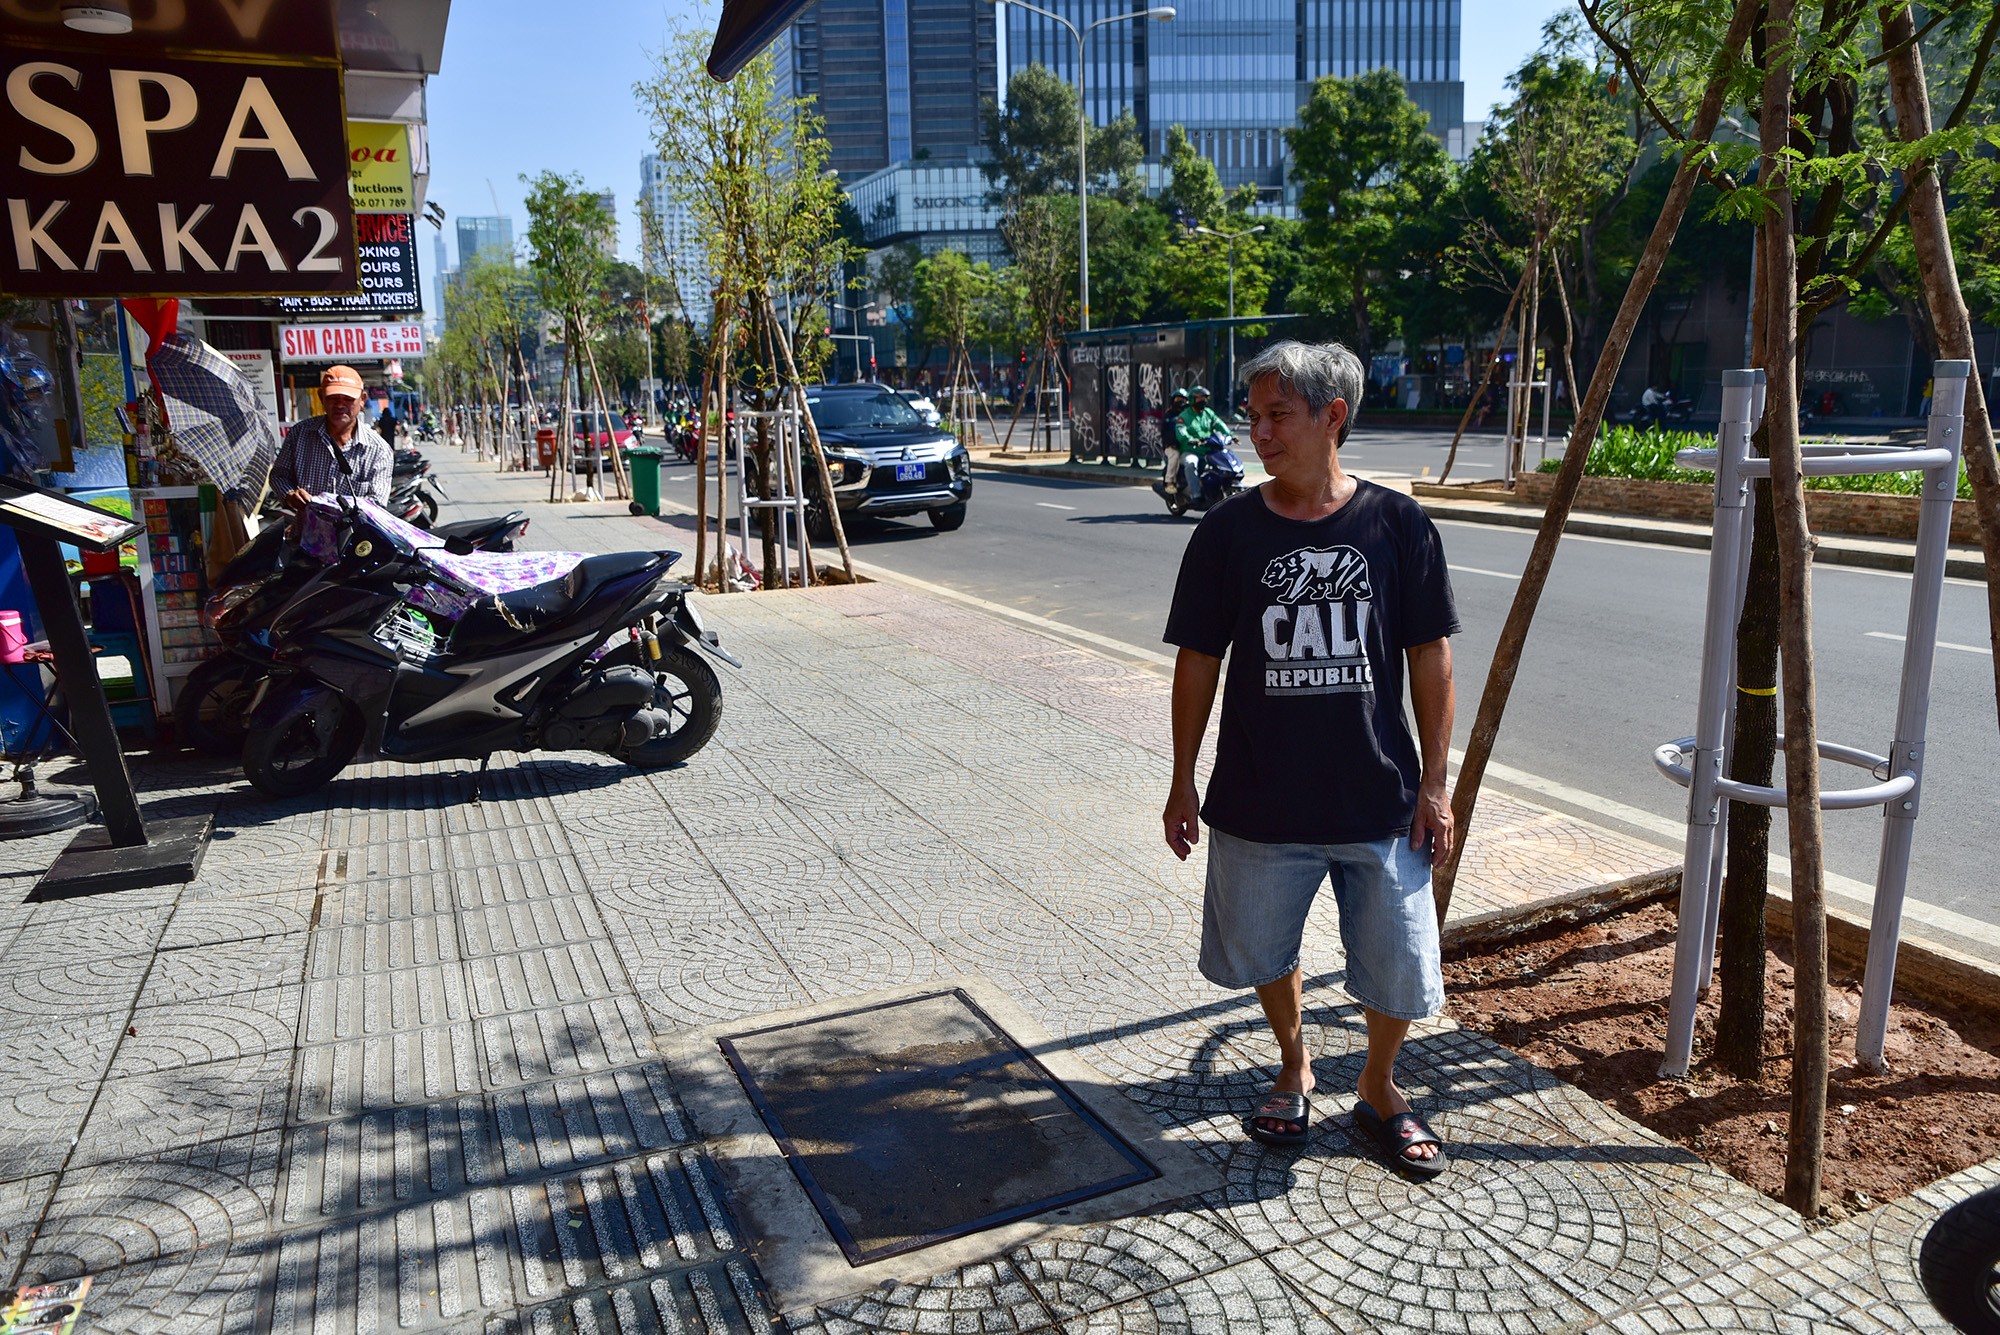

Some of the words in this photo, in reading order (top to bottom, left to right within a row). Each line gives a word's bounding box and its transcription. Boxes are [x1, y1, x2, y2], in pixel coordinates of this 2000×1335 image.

[5, 61, 320, 182] SPA
[368, 198, 386, 208] 071
[389, 198, 407, 208] 789
[912, 196, 966, 210] SAIGON
[6, 197, 343, 274] KAKA2
[360, 261, 402, 273] OURS
[360, 277, 404, 289] OURS
[310, 295, 333, 307] BUS
[371, 292, 415, 305] TICKETS
[285, 328, 318, 356] SIM
[322, 327, 367, 355] CARD
[370, 327, 388, 340] 4G
[401, 326, 419, 340] 5G
[371, 340, 421, 354] Esim
